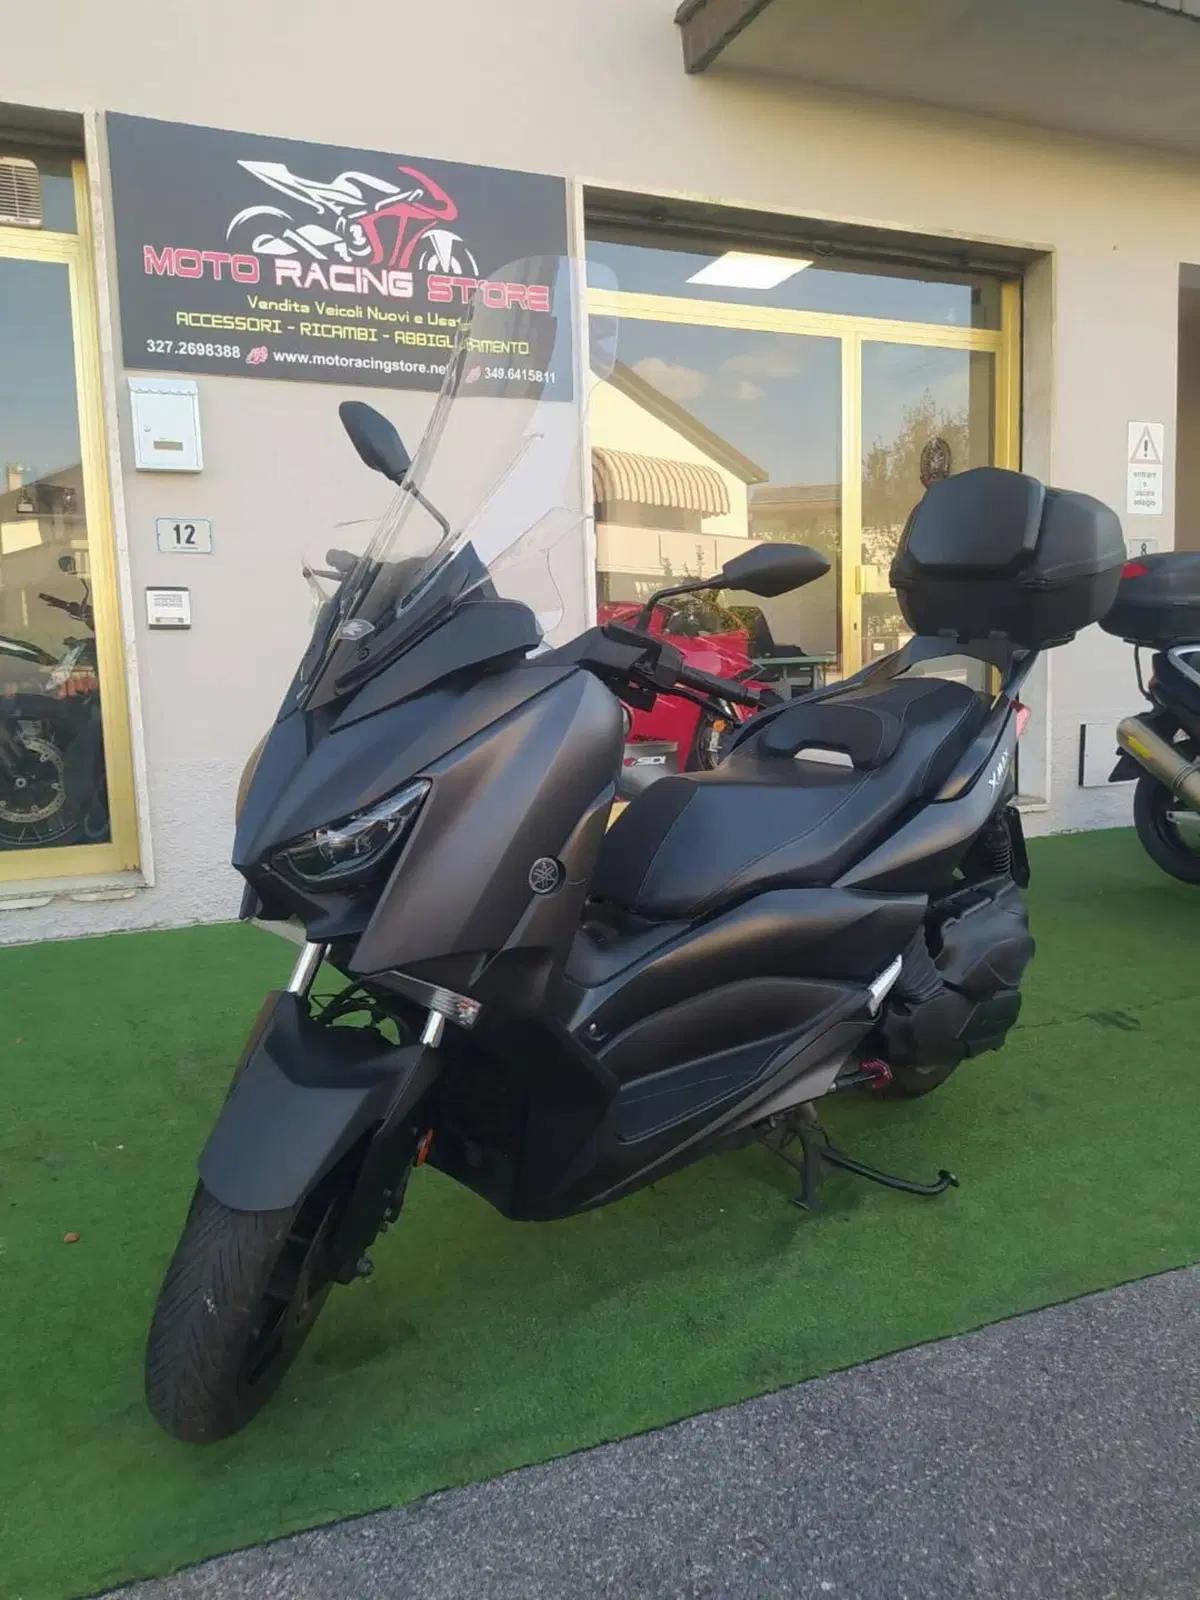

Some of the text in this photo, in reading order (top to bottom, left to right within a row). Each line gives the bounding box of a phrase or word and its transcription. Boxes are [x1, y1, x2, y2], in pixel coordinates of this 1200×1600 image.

[143, 245, 550, 312] MOTO RACING STORE
[247, 294, 311, 314] Vendita
[314, 300, 363, 319] Veicoli
[366, 305, 410, 324] Nuovi
[414, 314, 424, 324] e
[176, 311, 283, 334] ACCESSORI
[299, 321, 378, 342] RICAMBI
[394, 330, 530, 355] ABBIGLAMENTO
[146, 339, 241, 359] 327.2698388
[484, 366, 556, 384] 349.6415811
[173, 523, 196, 545] 12
